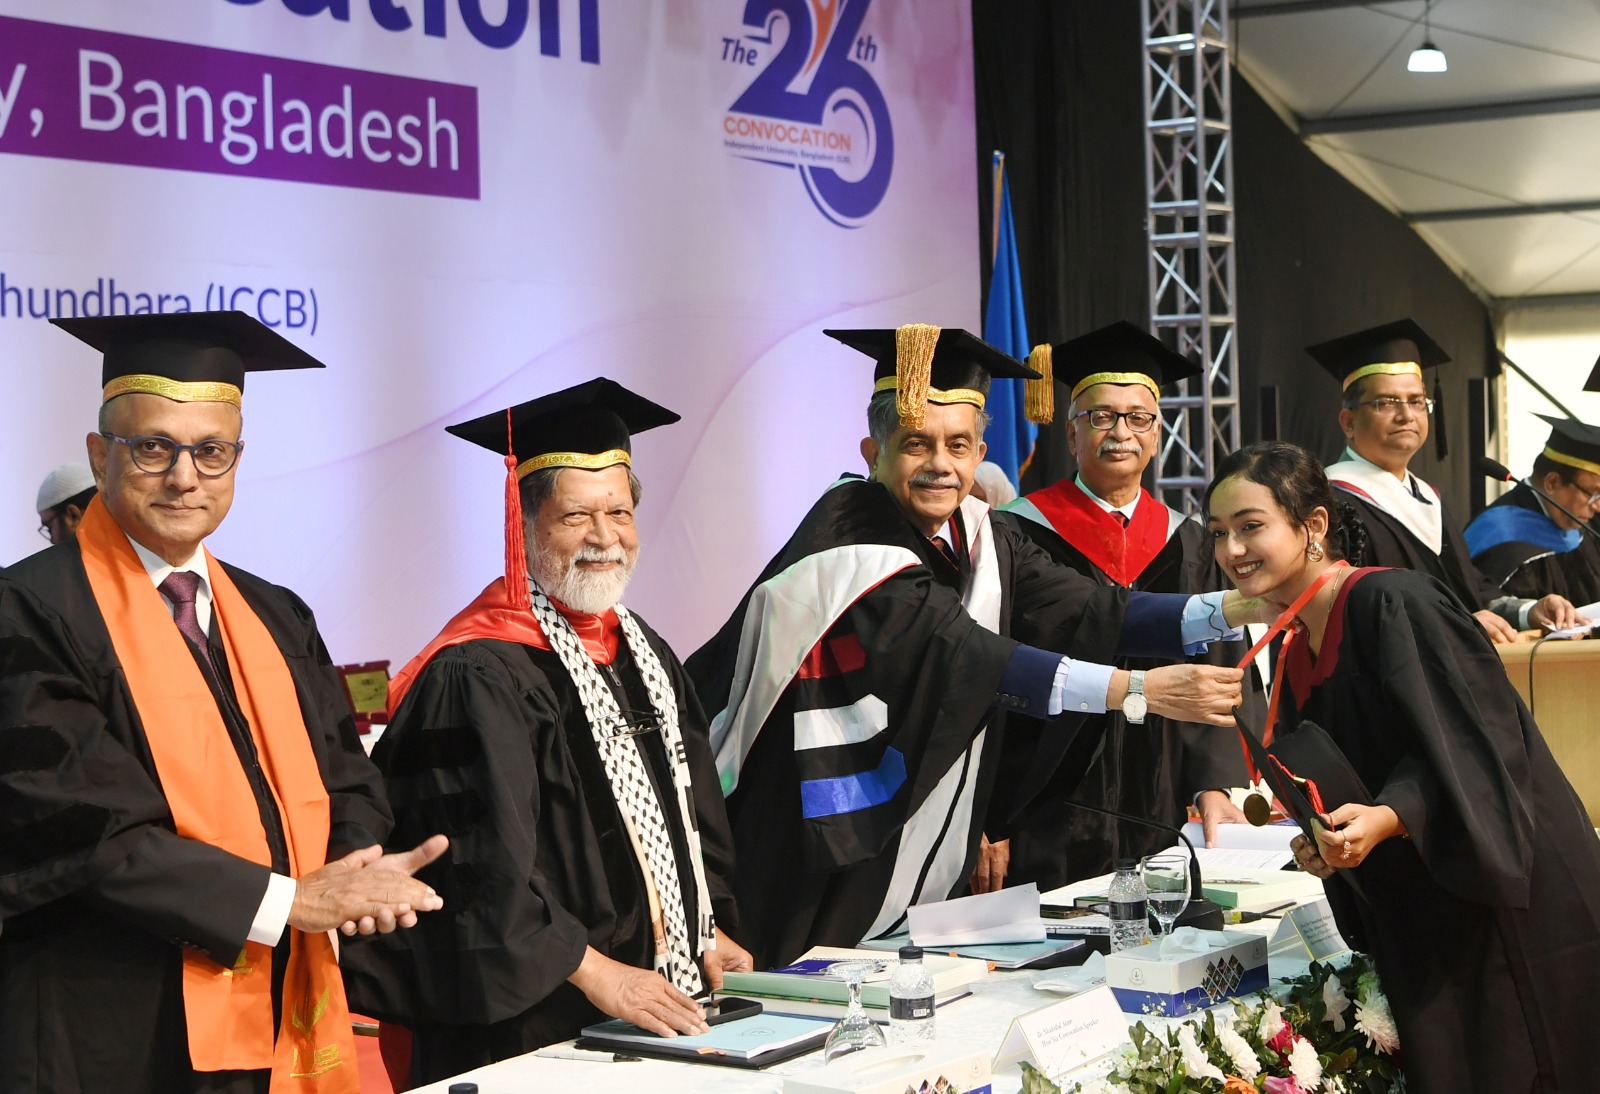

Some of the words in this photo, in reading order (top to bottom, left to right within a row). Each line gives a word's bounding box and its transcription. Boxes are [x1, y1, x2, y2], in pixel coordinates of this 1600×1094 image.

[722, 37, 758, 66] The
[79, 49, 459, 170] Bangladesh
[723, 116, 852, 153] CONVOCATION
[206, 282, 318, 336] (ICCB)
